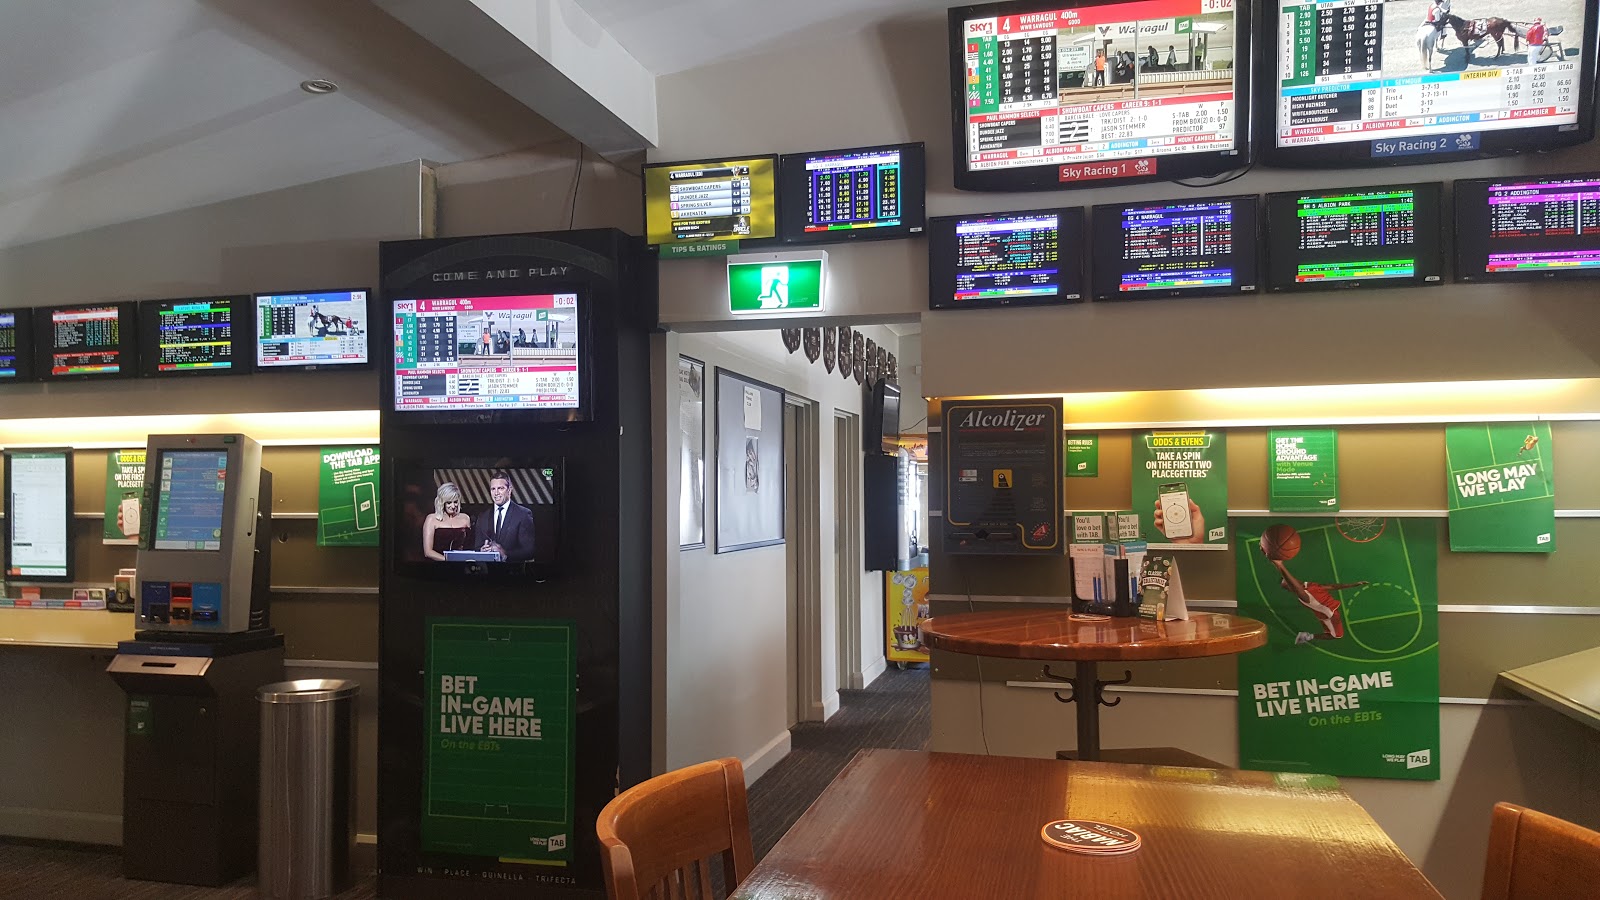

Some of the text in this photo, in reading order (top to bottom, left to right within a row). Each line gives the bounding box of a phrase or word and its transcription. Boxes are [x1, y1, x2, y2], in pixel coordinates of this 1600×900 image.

[1003, 11, 1078, 32] 4 WARRAGUL 400m
[1121, 101, 1143, 109] CAREER
[1438, 115, 1470, 123] ADDINGTON
[1523, 108, 1549, 116] GAMBIER
[1118, 123, 1146, 131] STEMMER
[1375, 138, 1447, 154] Sky Racing 2
[1062, 164, 1127, 178] Sky Racing 1
[696, 244, 727, 252] RATINGS
[432, 266, 569, 282] COME AND PLAY
[419, 301, 426, 311] 4
[959, 409, 1046, 432] Alcolizer
[1153, 437, 1204, 446] ODDS & EVENS
[323, 447, 374, 464] DOWNLOAD
[329, 454, 380, 470] THE TAB APP
[1156, 451, 1201, 460] TAKE A SPIN
[1275, 454, 1318, 462] ADVANTAGE
[121, 466, 133, 474] TAKE
[1145, 460, 1212, 469] ON THE FIRST TWO
[1456, 463, 1538, 487] LONG MAY
[1458, 477, 1527, 498] WE PLAY
[441, 674, 478, 695] BET
[1253, 670, 1394, 700] BET IN-GAME
[440, 694, 535, 717] IN-GAME
[1255, 692, 1360, 718] LIVE HERE
[440, 714, 542, 737] LIVE HERE
[1308, 711, 1383, 727] On the EBTs
[440, 738, 456, 749] On
[458, 739, 474, 750] the
[1409, 755, 1428, 764] TAB
[1054, 822, 1125, 846] NABIAC
[550, 838, 565, 847] TAB
[417, 866, 576, 884] WIN PLACE QUINELLA TRIFECTA
